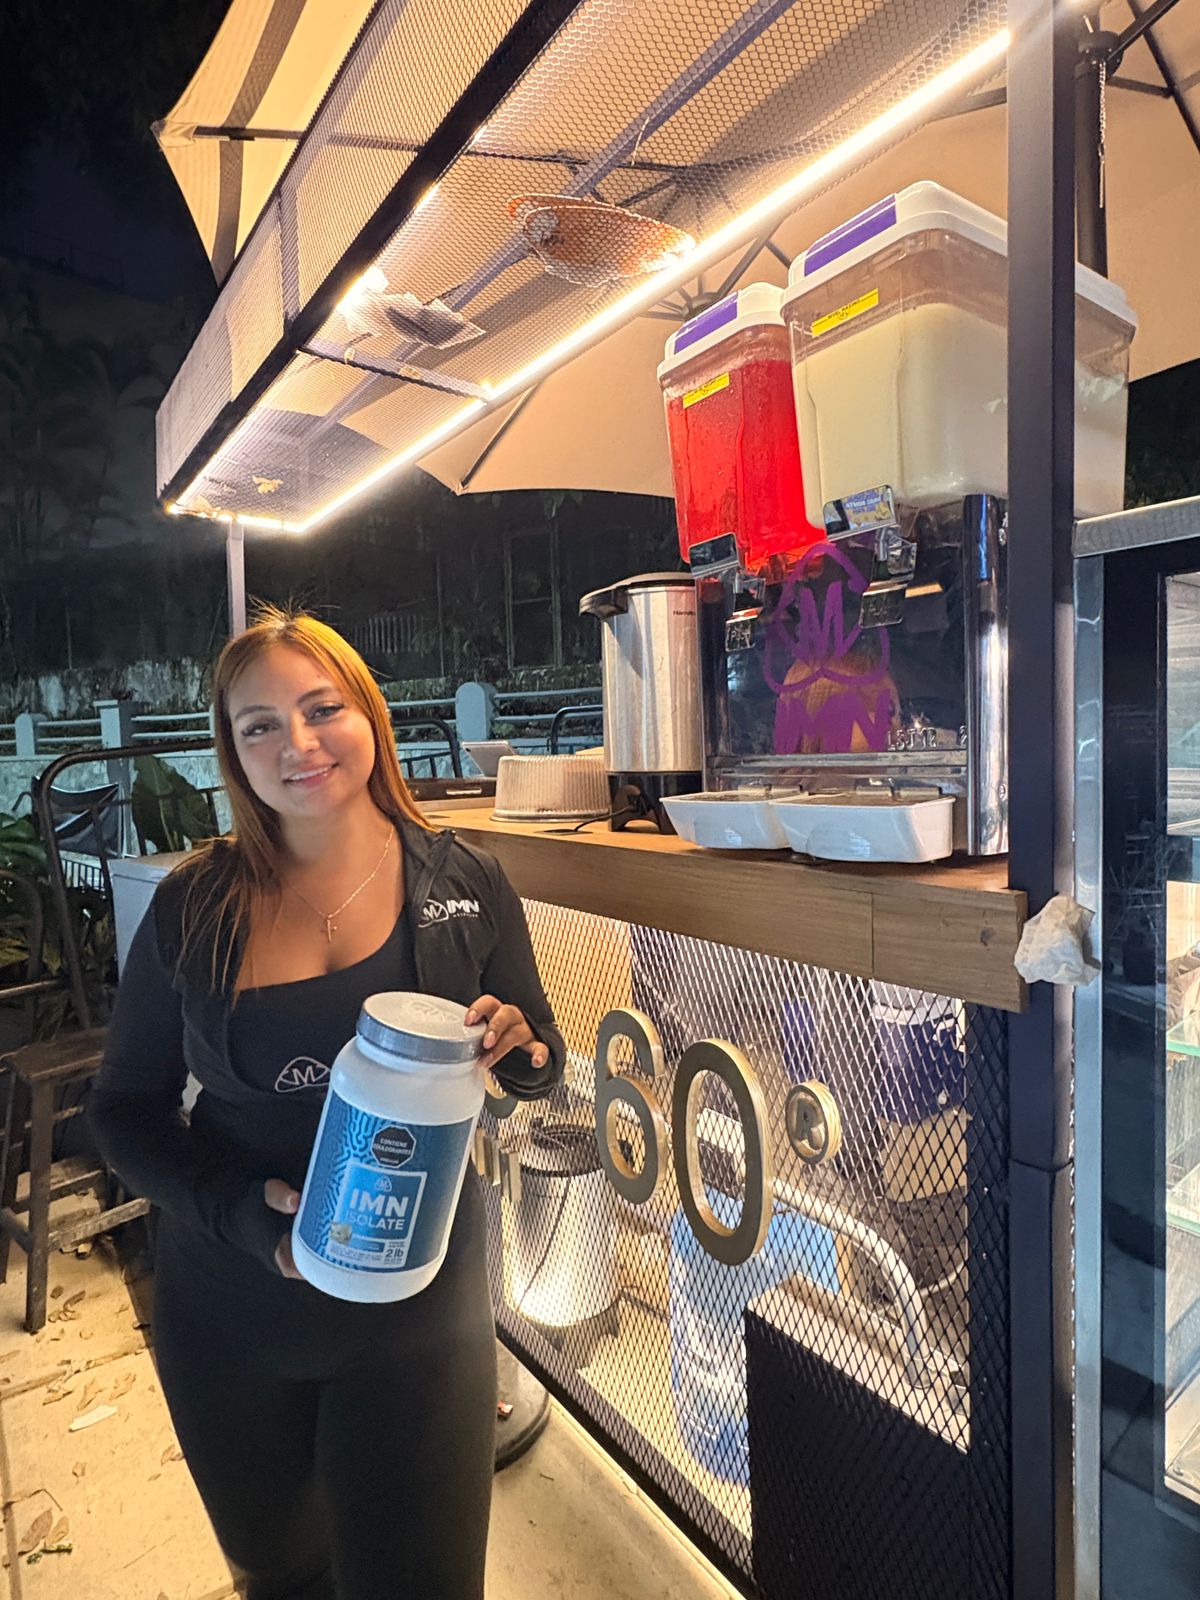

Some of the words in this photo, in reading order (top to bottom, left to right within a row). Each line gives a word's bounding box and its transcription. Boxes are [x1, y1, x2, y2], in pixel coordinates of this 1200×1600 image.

[446, 899, 480, 914] IMN
[349, 1188, 409, 1218] IMN
[346, 1209, 406, 1231] ISOLATE
[385, 1248, 394, 1258] 2
[394, 1247, 404, 1258] lb
